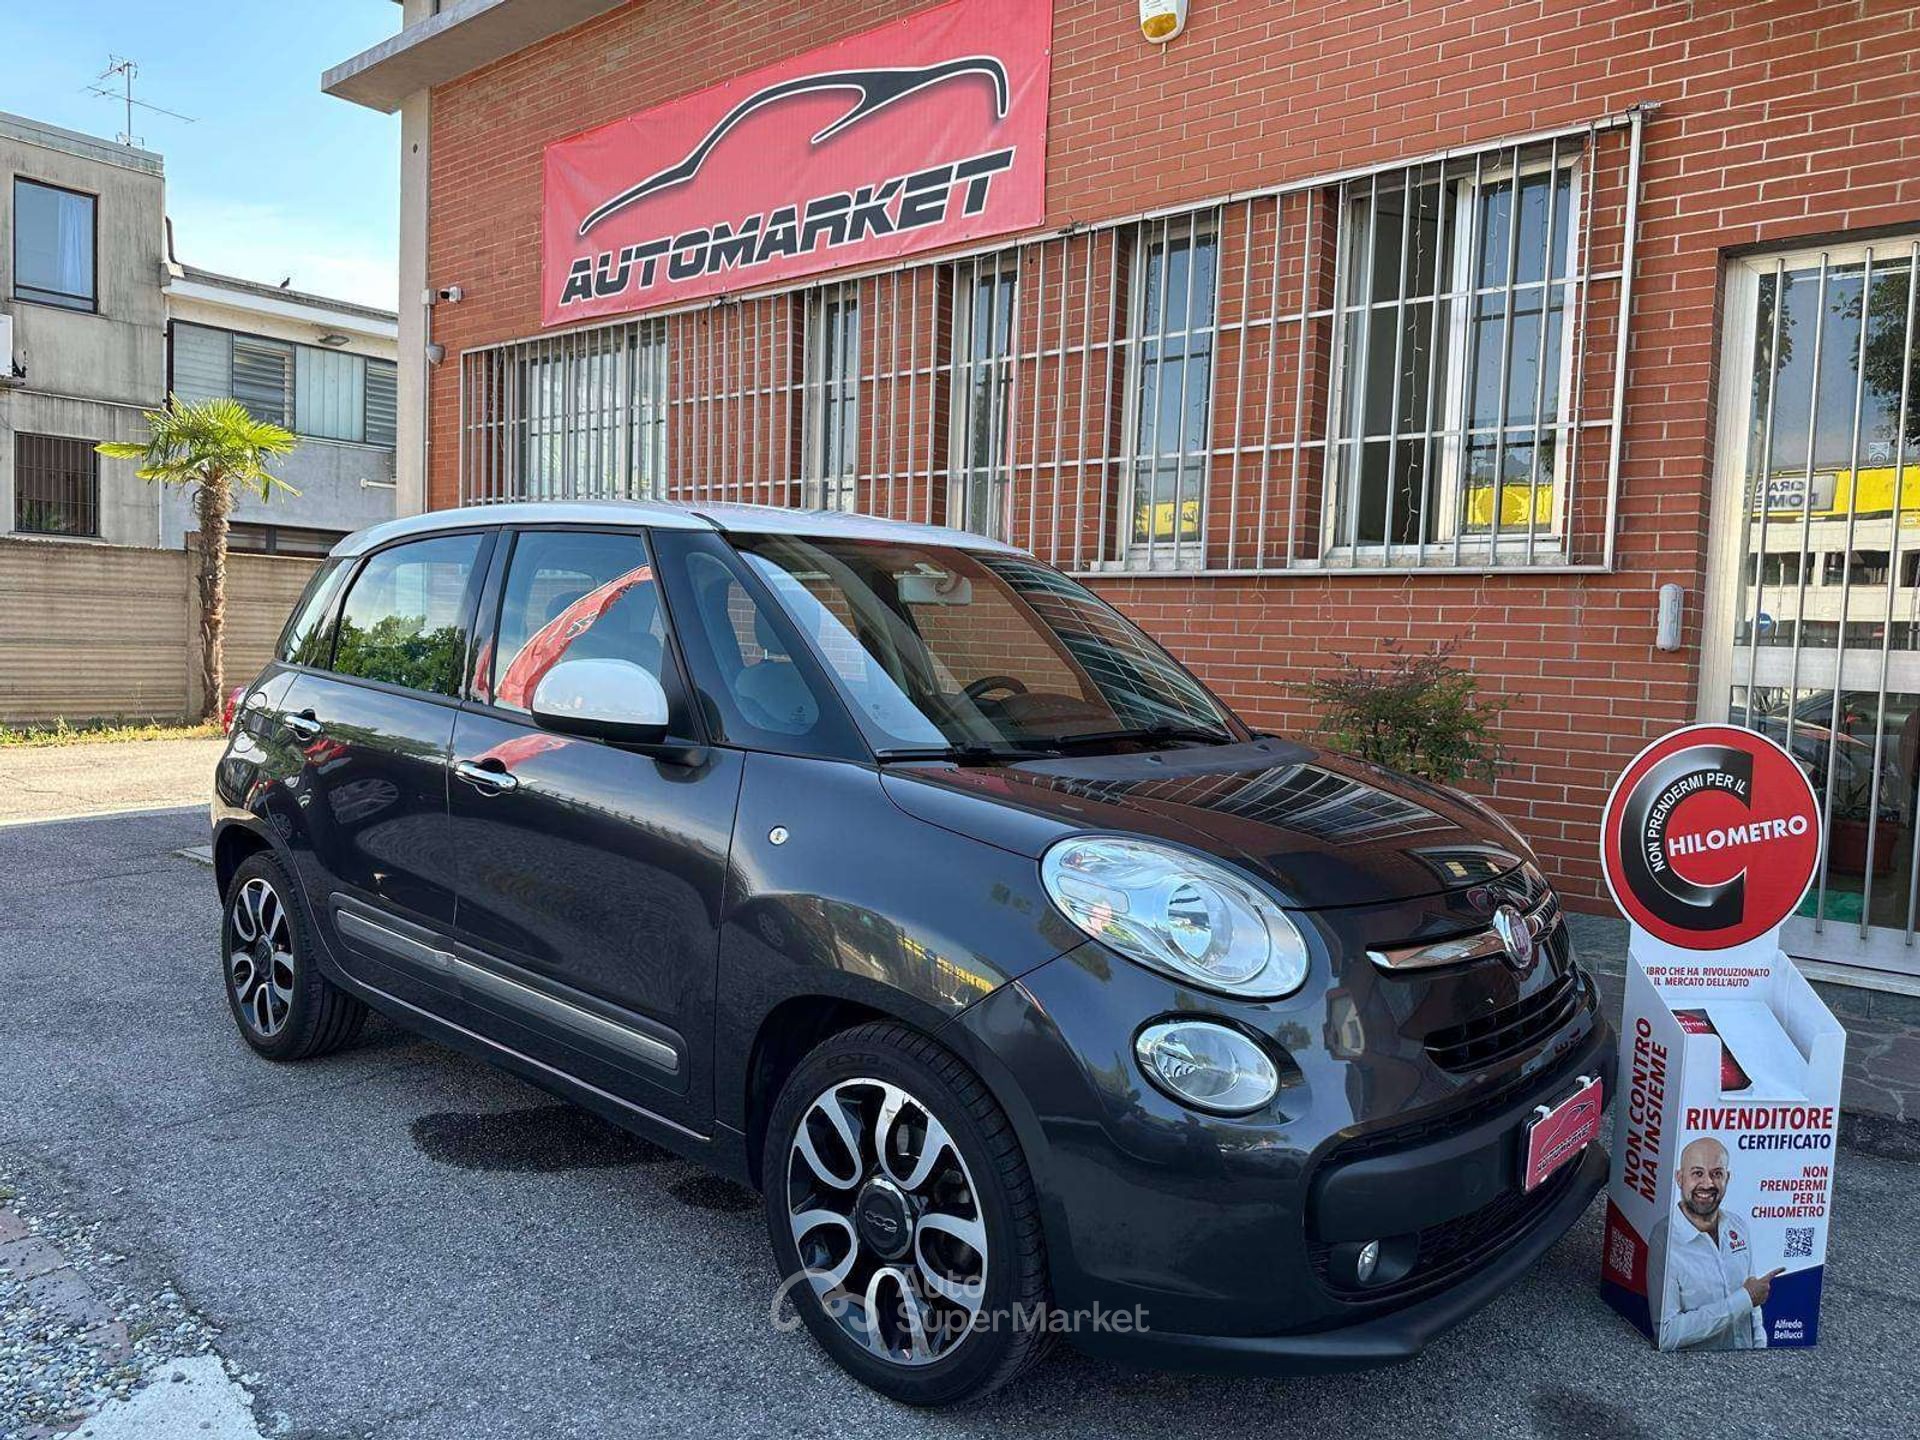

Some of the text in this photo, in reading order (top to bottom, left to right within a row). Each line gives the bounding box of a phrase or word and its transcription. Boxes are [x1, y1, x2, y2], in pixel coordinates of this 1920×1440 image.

[560, 146, 1017, 306] AUTOMARKET
[1647, 772, 1746, 872] NON PRENDERMI PER IL
[1668, 814, 1808, 857] HILOMETRO
[1642, 966, 1770, 977] IBRO CHE HA RIVOLUZIONATO
[1654, 977, 1750, 987] IL MERCATO DELL'AUTO
[1623, 1017, 1652, 1192] NON CONTRO
[1639, 1041, 1668, 1204] MA INSIEME
[1686, 1107, 1834, 1131] RIVENDITORE
[1738, 1133, 1831, 1150] CERTIFICATO
[1802, 1166, 1829, 1178] NON
[1760, 1179, 1828, 1192] PRENDERMI
[1792, 1192, 1826, 1204] PER IL
[1751, 1205, 1825, 1218] CHILOMETRO
[1774, 1319, 1803, 1329] Alfredo
[1773, 1329, 1803, 1339] Bellucci
